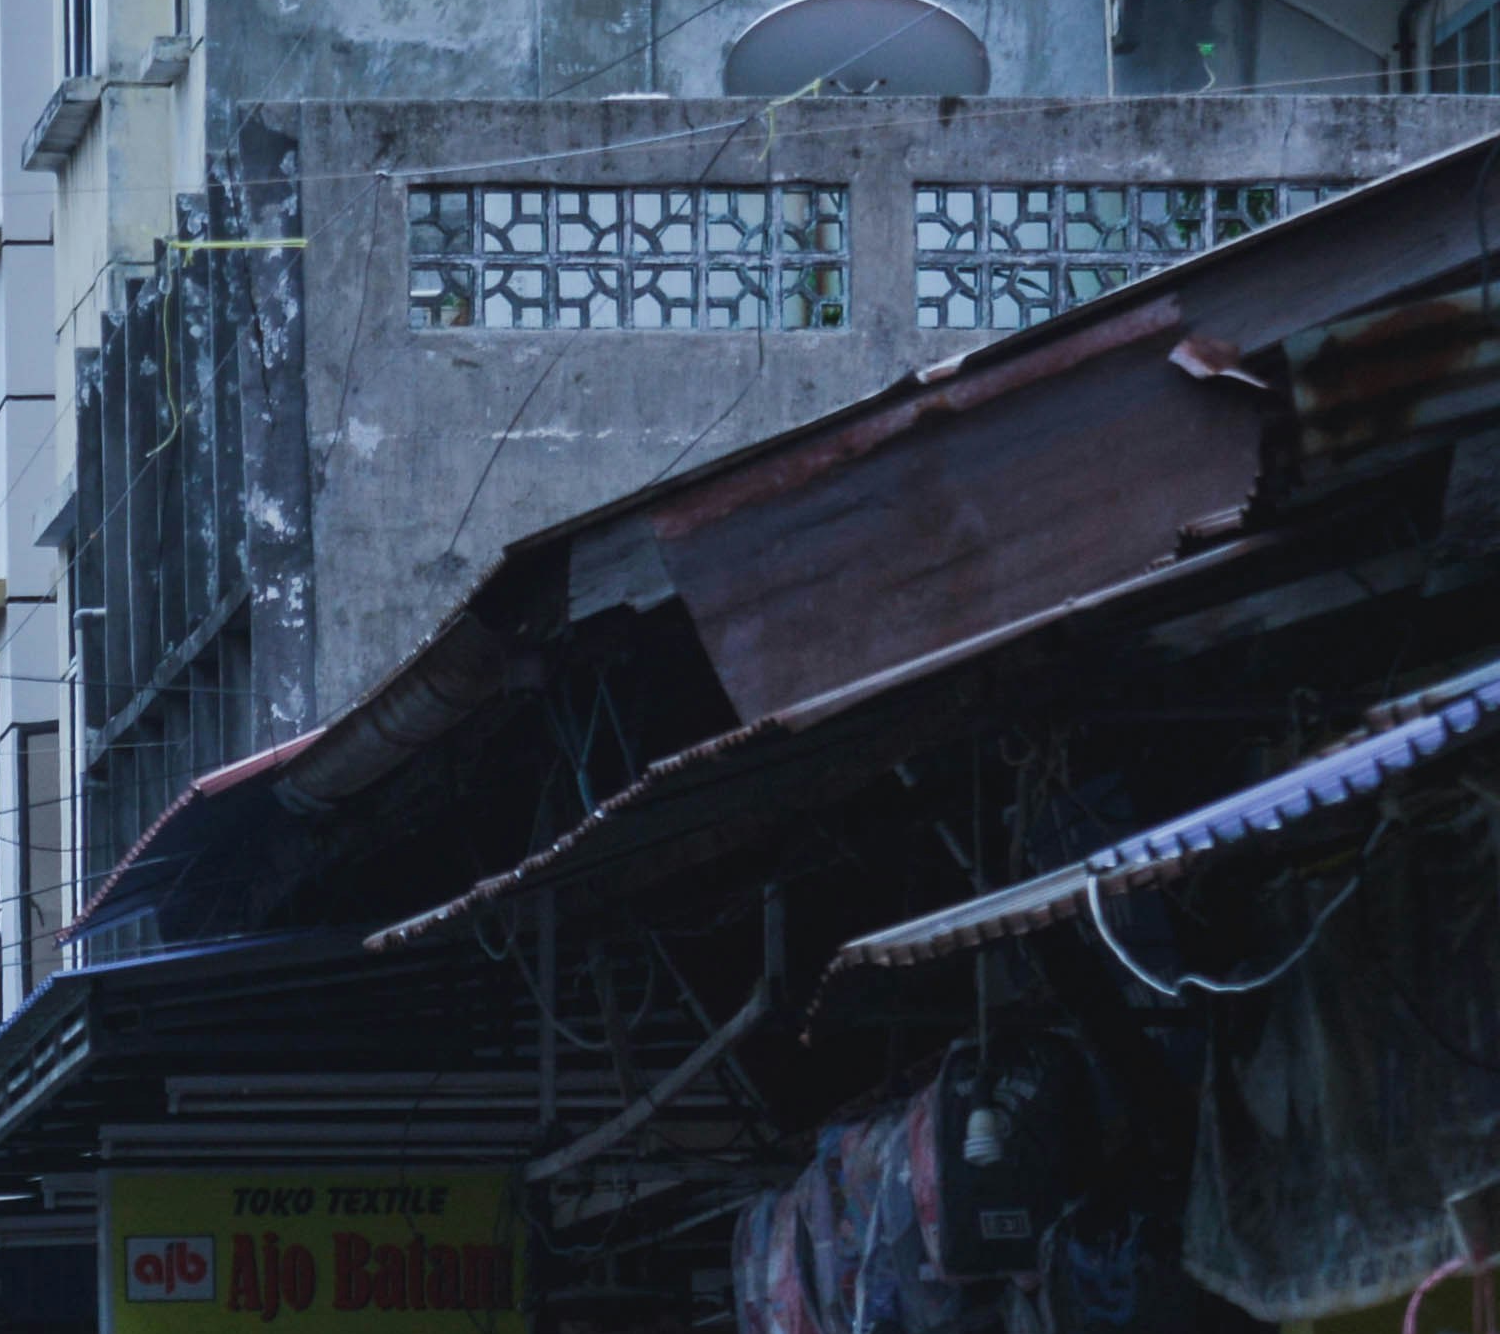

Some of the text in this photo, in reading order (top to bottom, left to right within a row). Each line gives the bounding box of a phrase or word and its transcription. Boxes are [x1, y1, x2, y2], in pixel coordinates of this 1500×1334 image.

[233, 1187, 449, 1216] TOKO TEXTILE
[134, 1231, 514, 1322] ajb Ajo Batam
